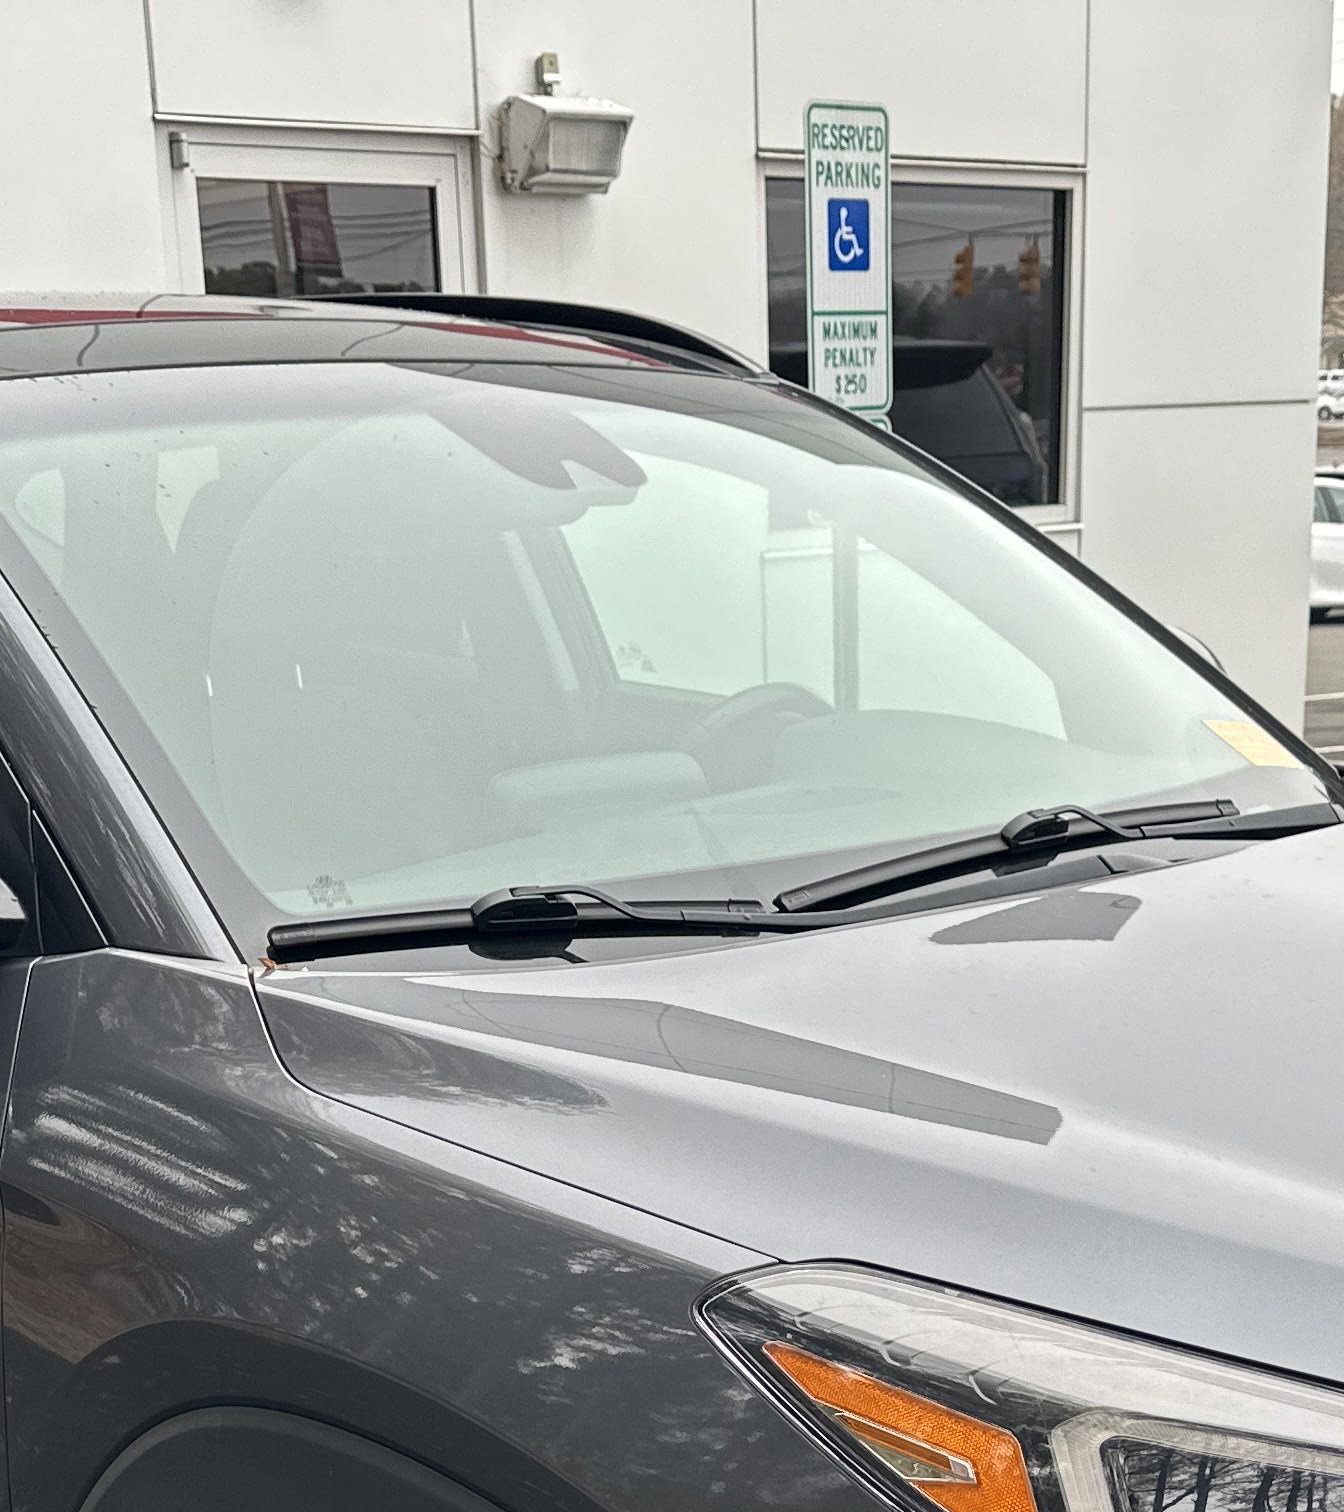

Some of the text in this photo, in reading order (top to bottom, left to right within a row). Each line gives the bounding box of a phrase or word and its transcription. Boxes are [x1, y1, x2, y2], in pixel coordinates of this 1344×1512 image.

[811, 122, 885, 152] RESERVED
[815, 160, 882, 190] PARKING
[822, 319, 878, 342] MAXIMUM
[823, 346, 878, 369] PENALTY
[835, 373, 867, 395] $250
